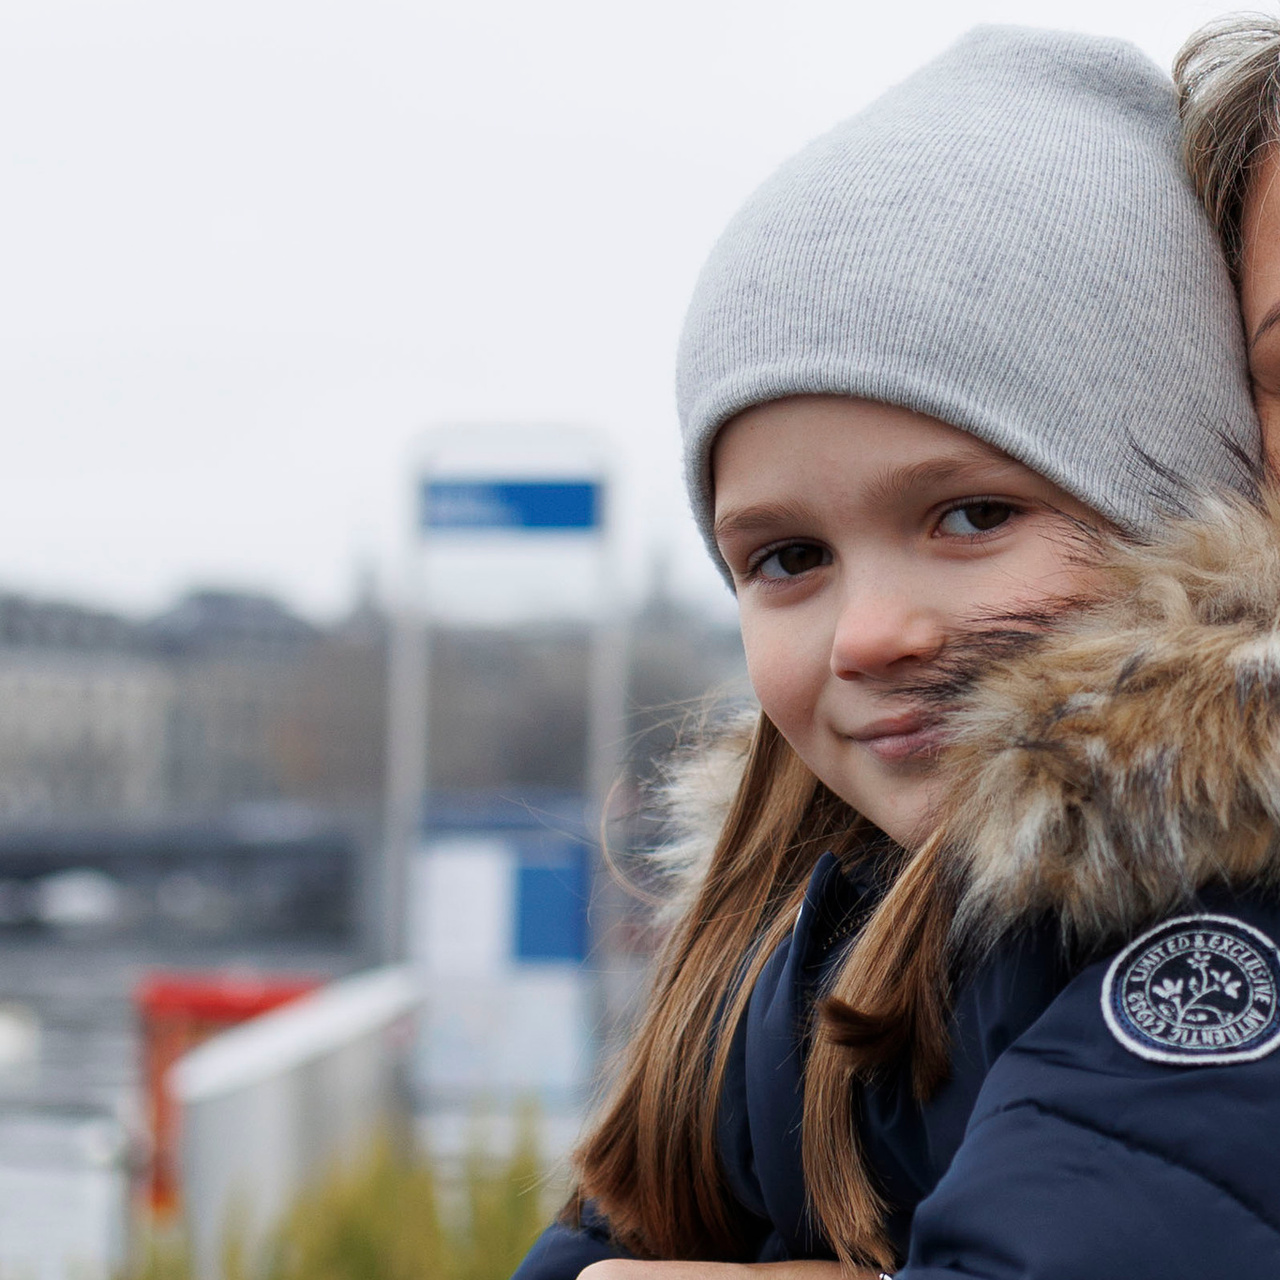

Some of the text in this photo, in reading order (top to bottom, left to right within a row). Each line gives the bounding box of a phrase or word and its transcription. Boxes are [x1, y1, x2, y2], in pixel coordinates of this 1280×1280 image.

[1130, 934, 1271, 1006] LIMITED & EXCLUSIVE
[1168, 1008, 1267, 1045] AUTHENTIC
